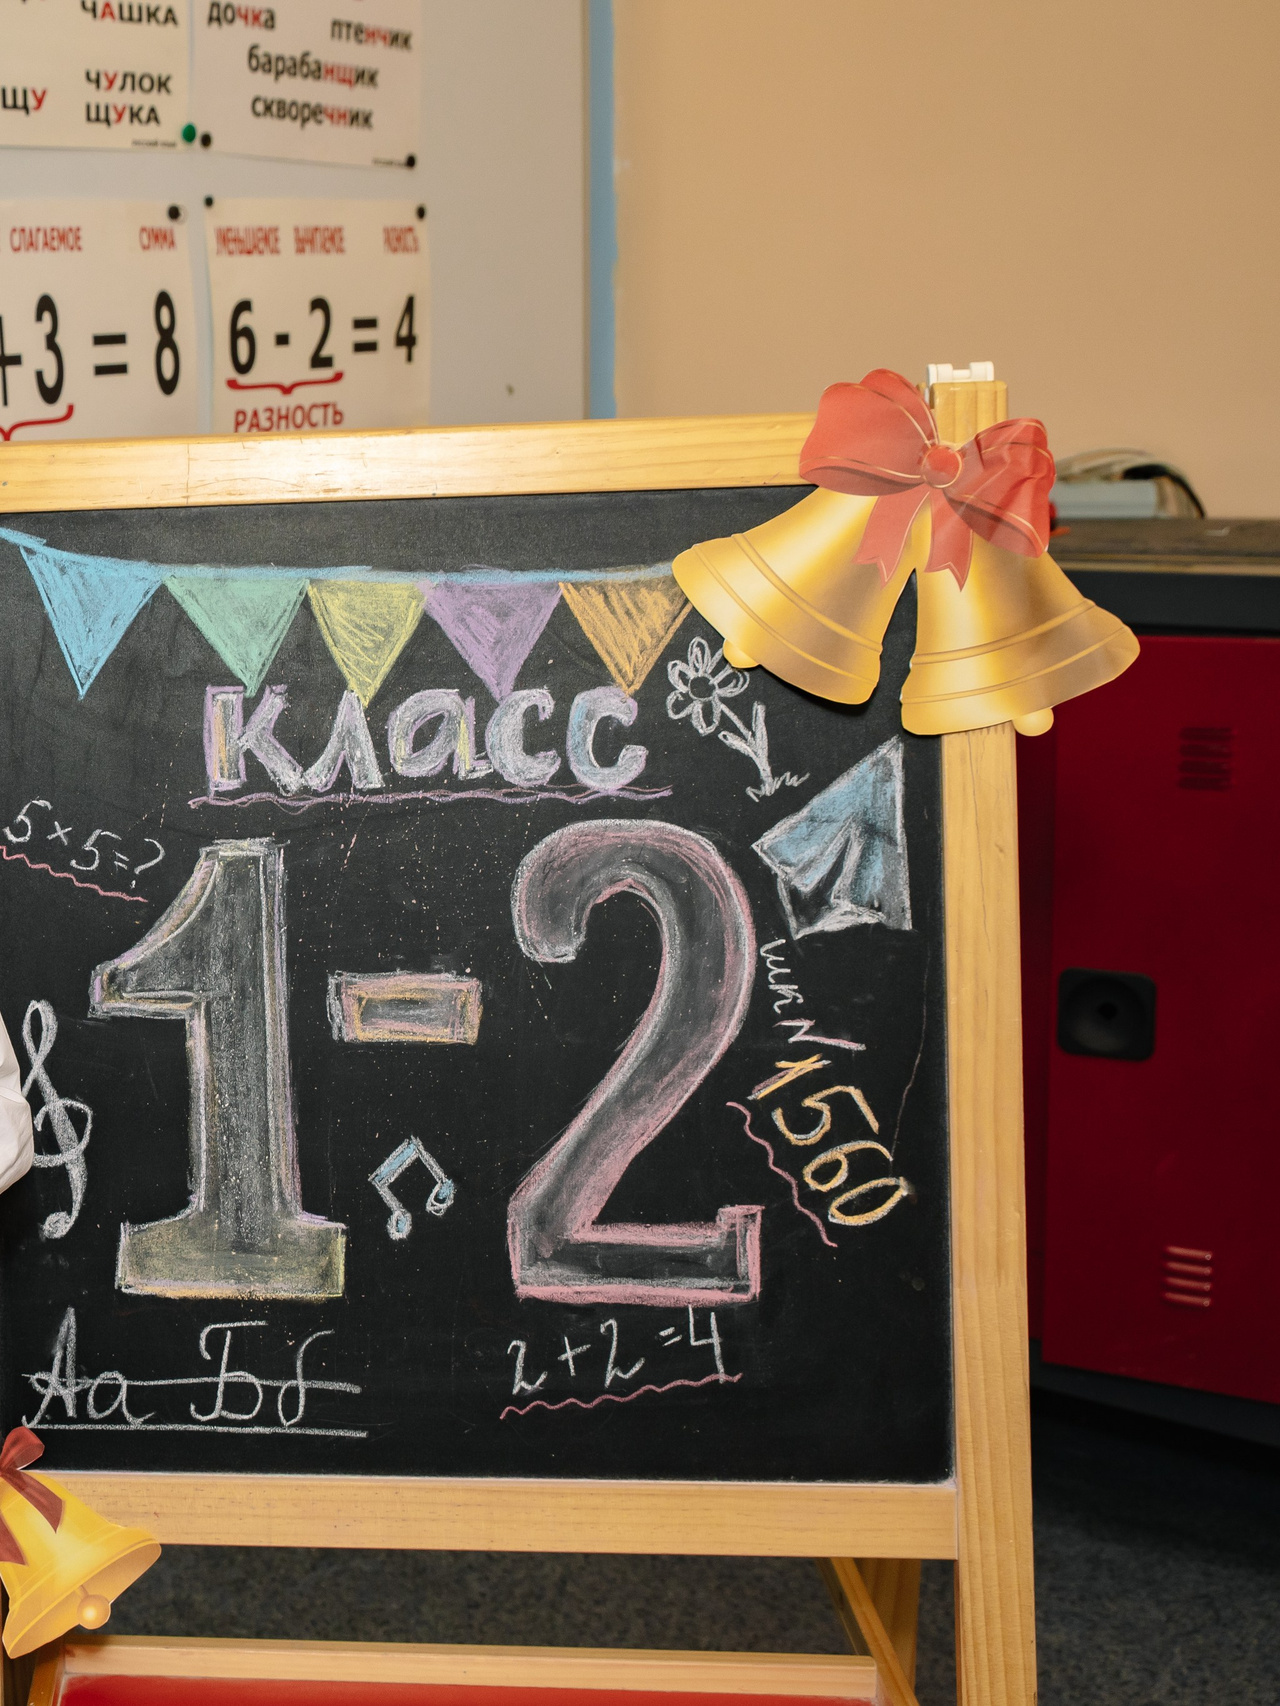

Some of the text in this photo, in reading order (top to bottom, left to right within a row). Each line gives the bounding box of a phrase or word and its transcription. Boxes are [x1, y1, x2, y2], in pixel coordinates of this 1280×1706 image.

[81, 0, 179, 27] ЧАШКА
[207, 0, 276, 30] дочка
[330, 18, 413, 51] птенчик
[86, 69, 172, 94] ЧУЛОК
[248, 44, 379, 90] барабанщик
[1, 86, 47, 115] ЩУ
[86, 102, 161, 127] ЩУКА
[251, 95, 374, 129] скворечник
[9, 226, 83, 252] СЛАГАЕМОЕ
[234, 402, 344, 433] РАЗНОСТЬ
